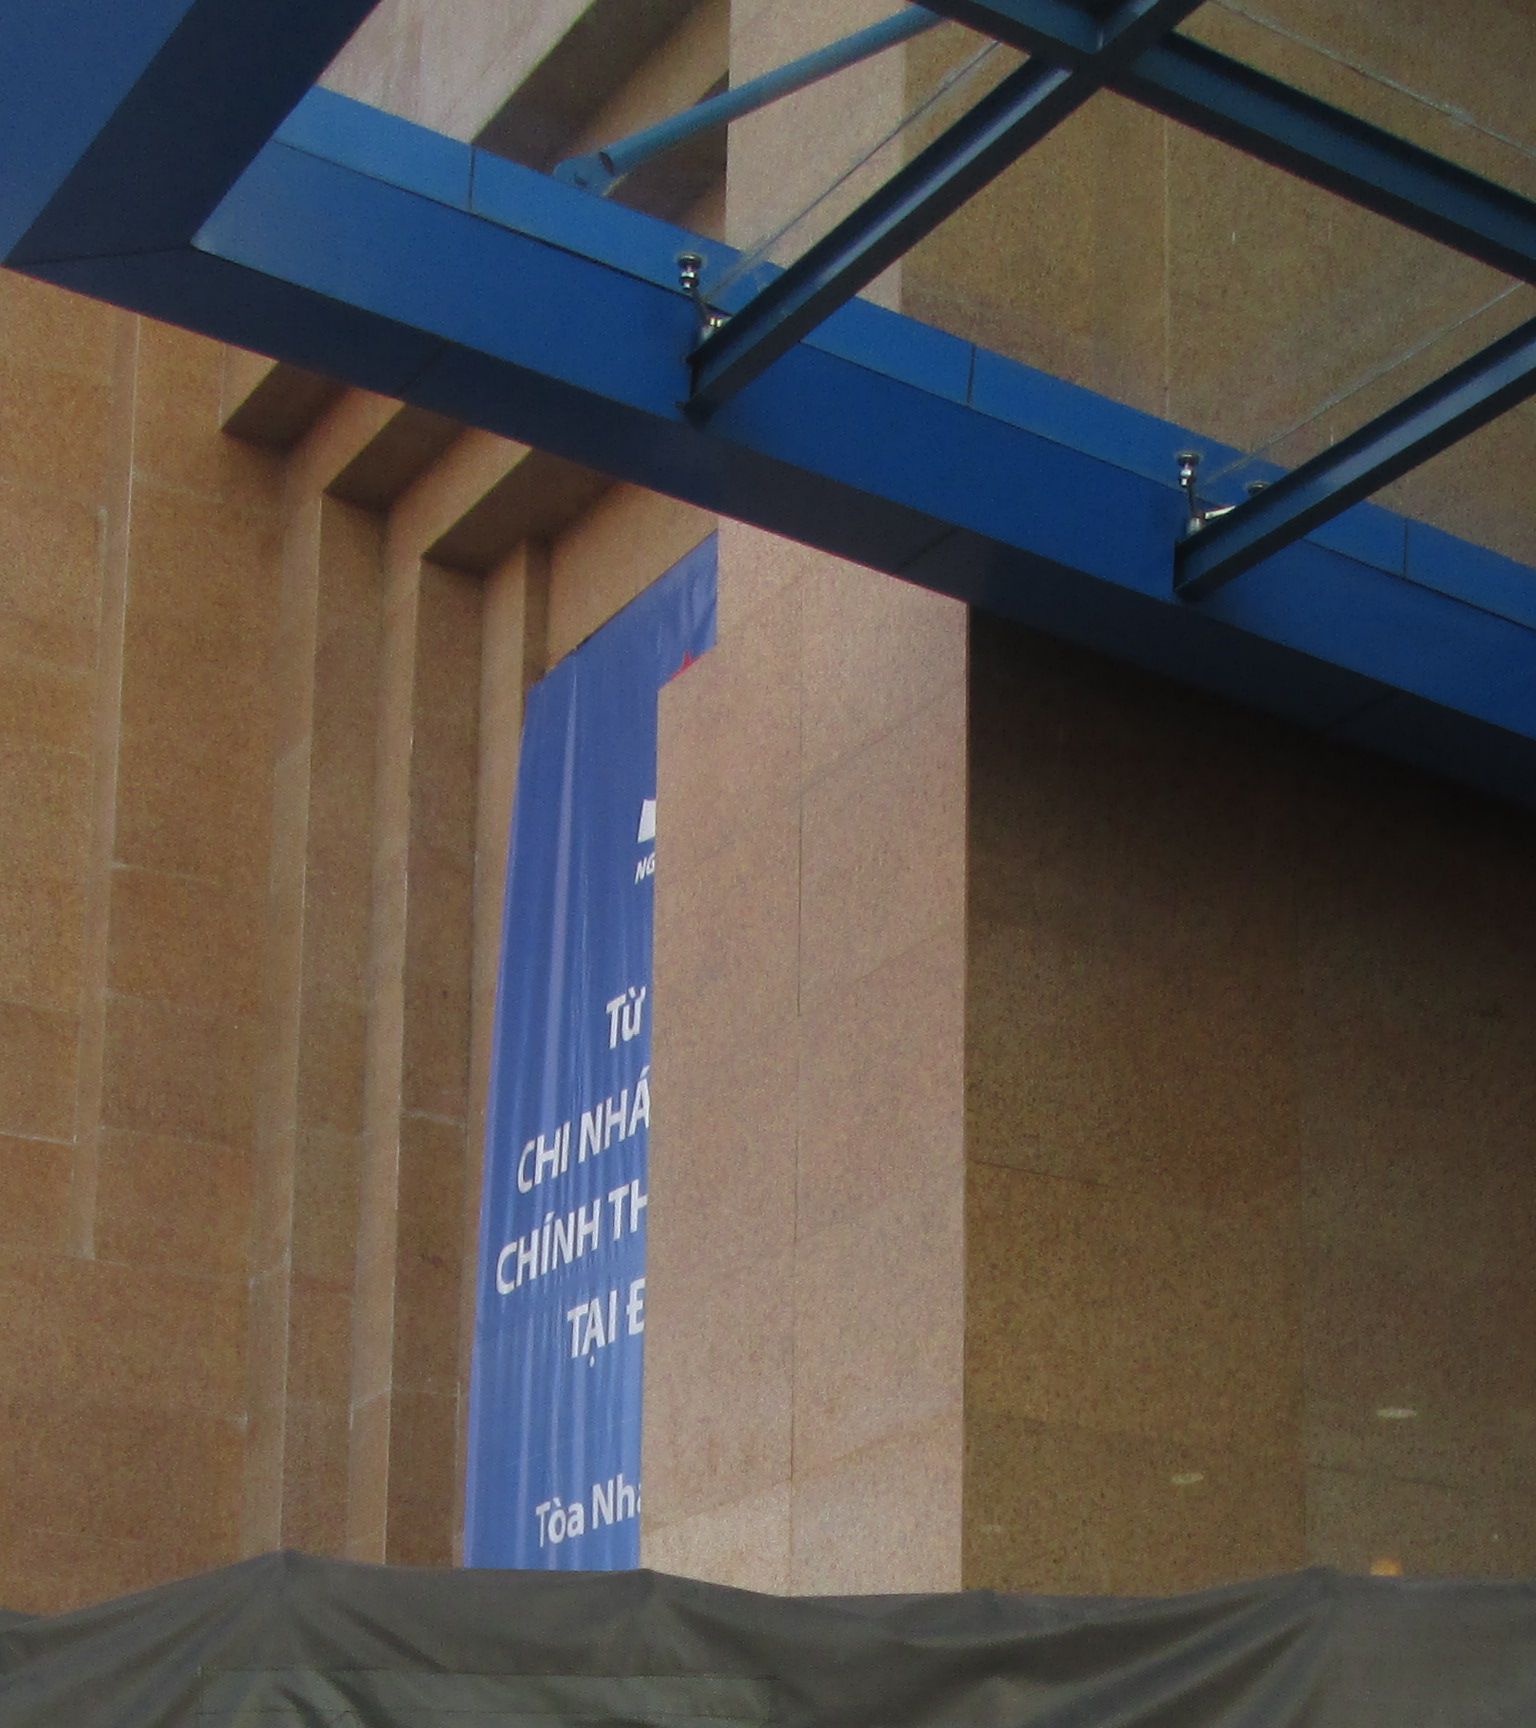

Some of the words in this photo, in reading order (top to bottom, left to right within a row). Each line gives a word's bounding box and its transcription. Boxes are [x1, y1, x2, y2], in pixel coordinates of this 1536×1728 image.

[606, 985, 647, 1050] Từ
[518, 1120, 572, 1194] CHI
[496, 1198, 601, 1296] CHÍNH
[567, 1289, 618, 1368] TẠI
[535, 1496, 585, 1548] Tòa
